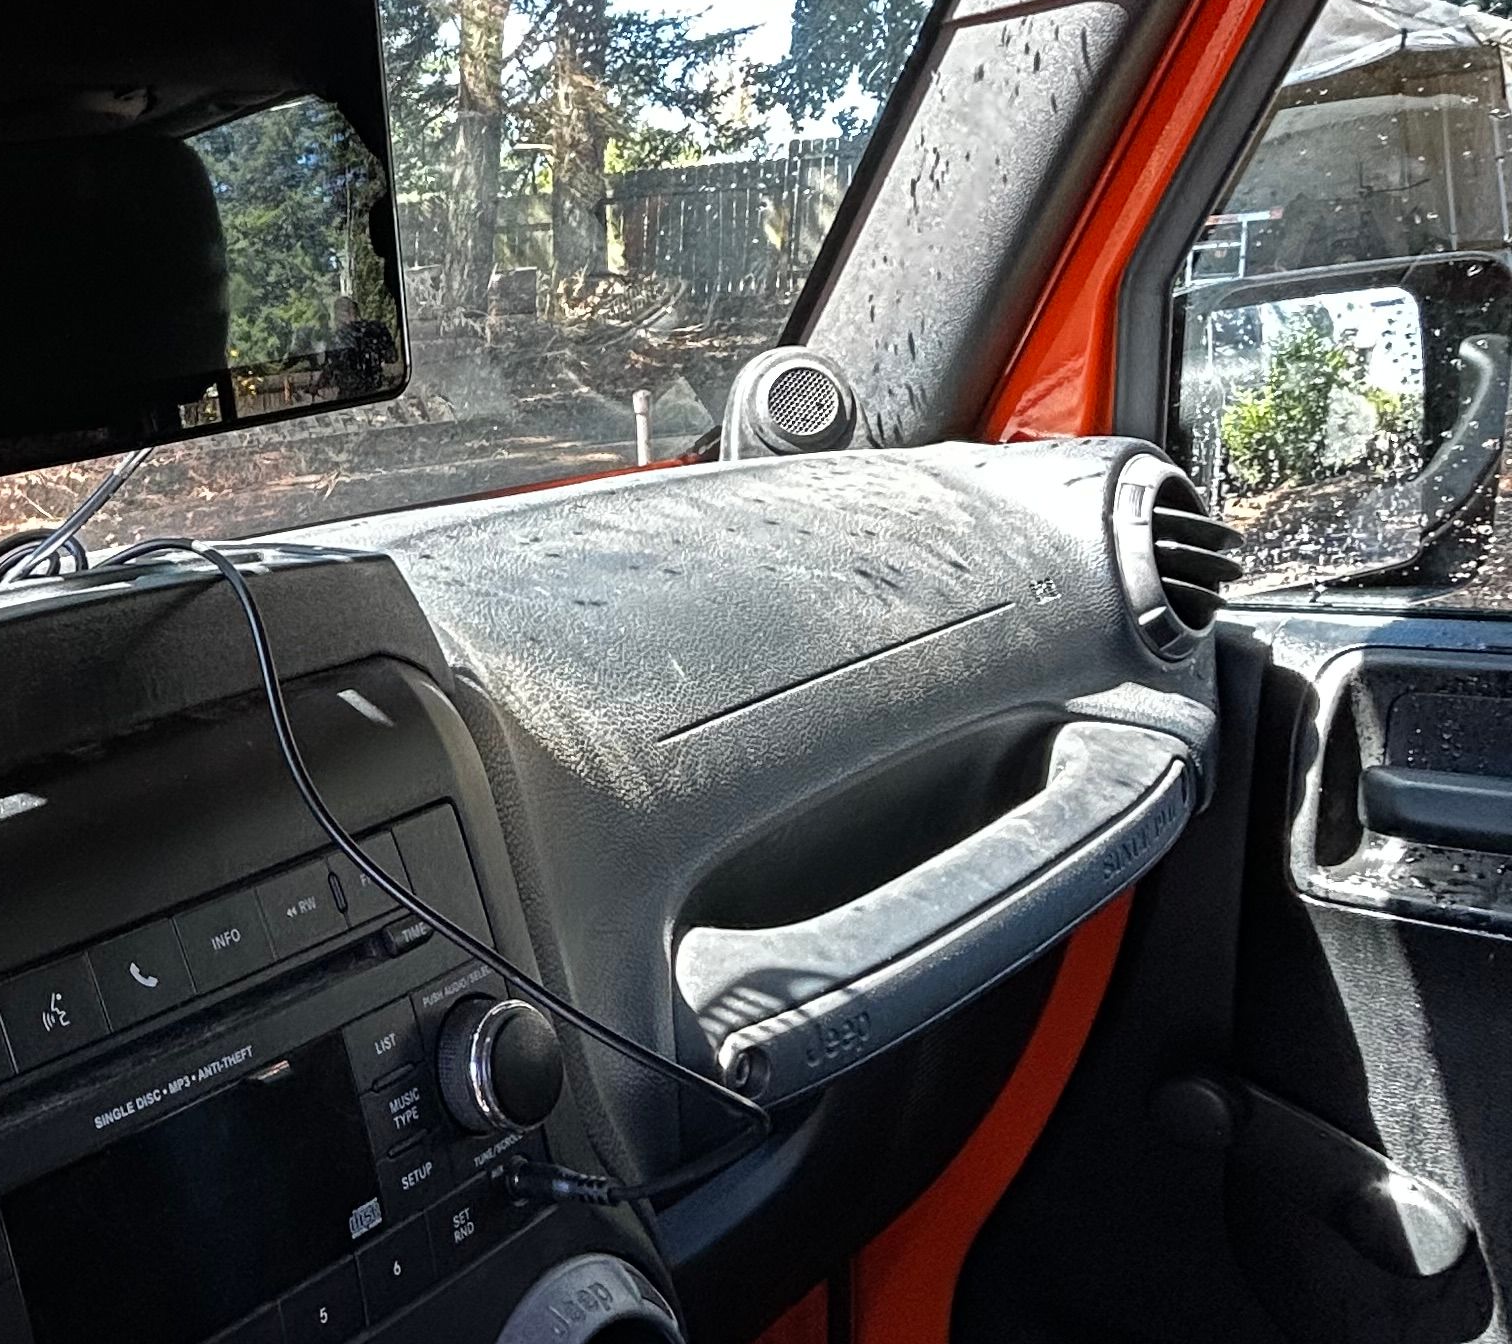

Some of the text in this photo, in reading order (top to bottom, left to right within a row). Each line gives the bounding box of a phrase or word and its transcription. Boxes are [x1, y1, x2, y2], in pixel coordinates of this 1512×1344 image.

[298, 896, 317, 914] RW
[211, 928, 241, 951] INFO
[401, 921, 428, 943] TIME
[374, 1032, 397, 1055] LIST
[806, 1010, 872, 1069] Jeep
[94, 1045, 253, 1129] SINGLE DISC MP3 ANTI-THEFT
[389, 1087, 421, 1114] MUSIC
[393, 1106, 420, 1130] TYPE
[401, 1161, 433, 1190] SETUP
[453, 1208, 470, 1229] SET
[453, 1221, 475, 1244] RND
[393, 1260, 402, 1276] 6
[320, 1307, 329, 1324] 5
[550, 1282, 614, 1338] Jeep
